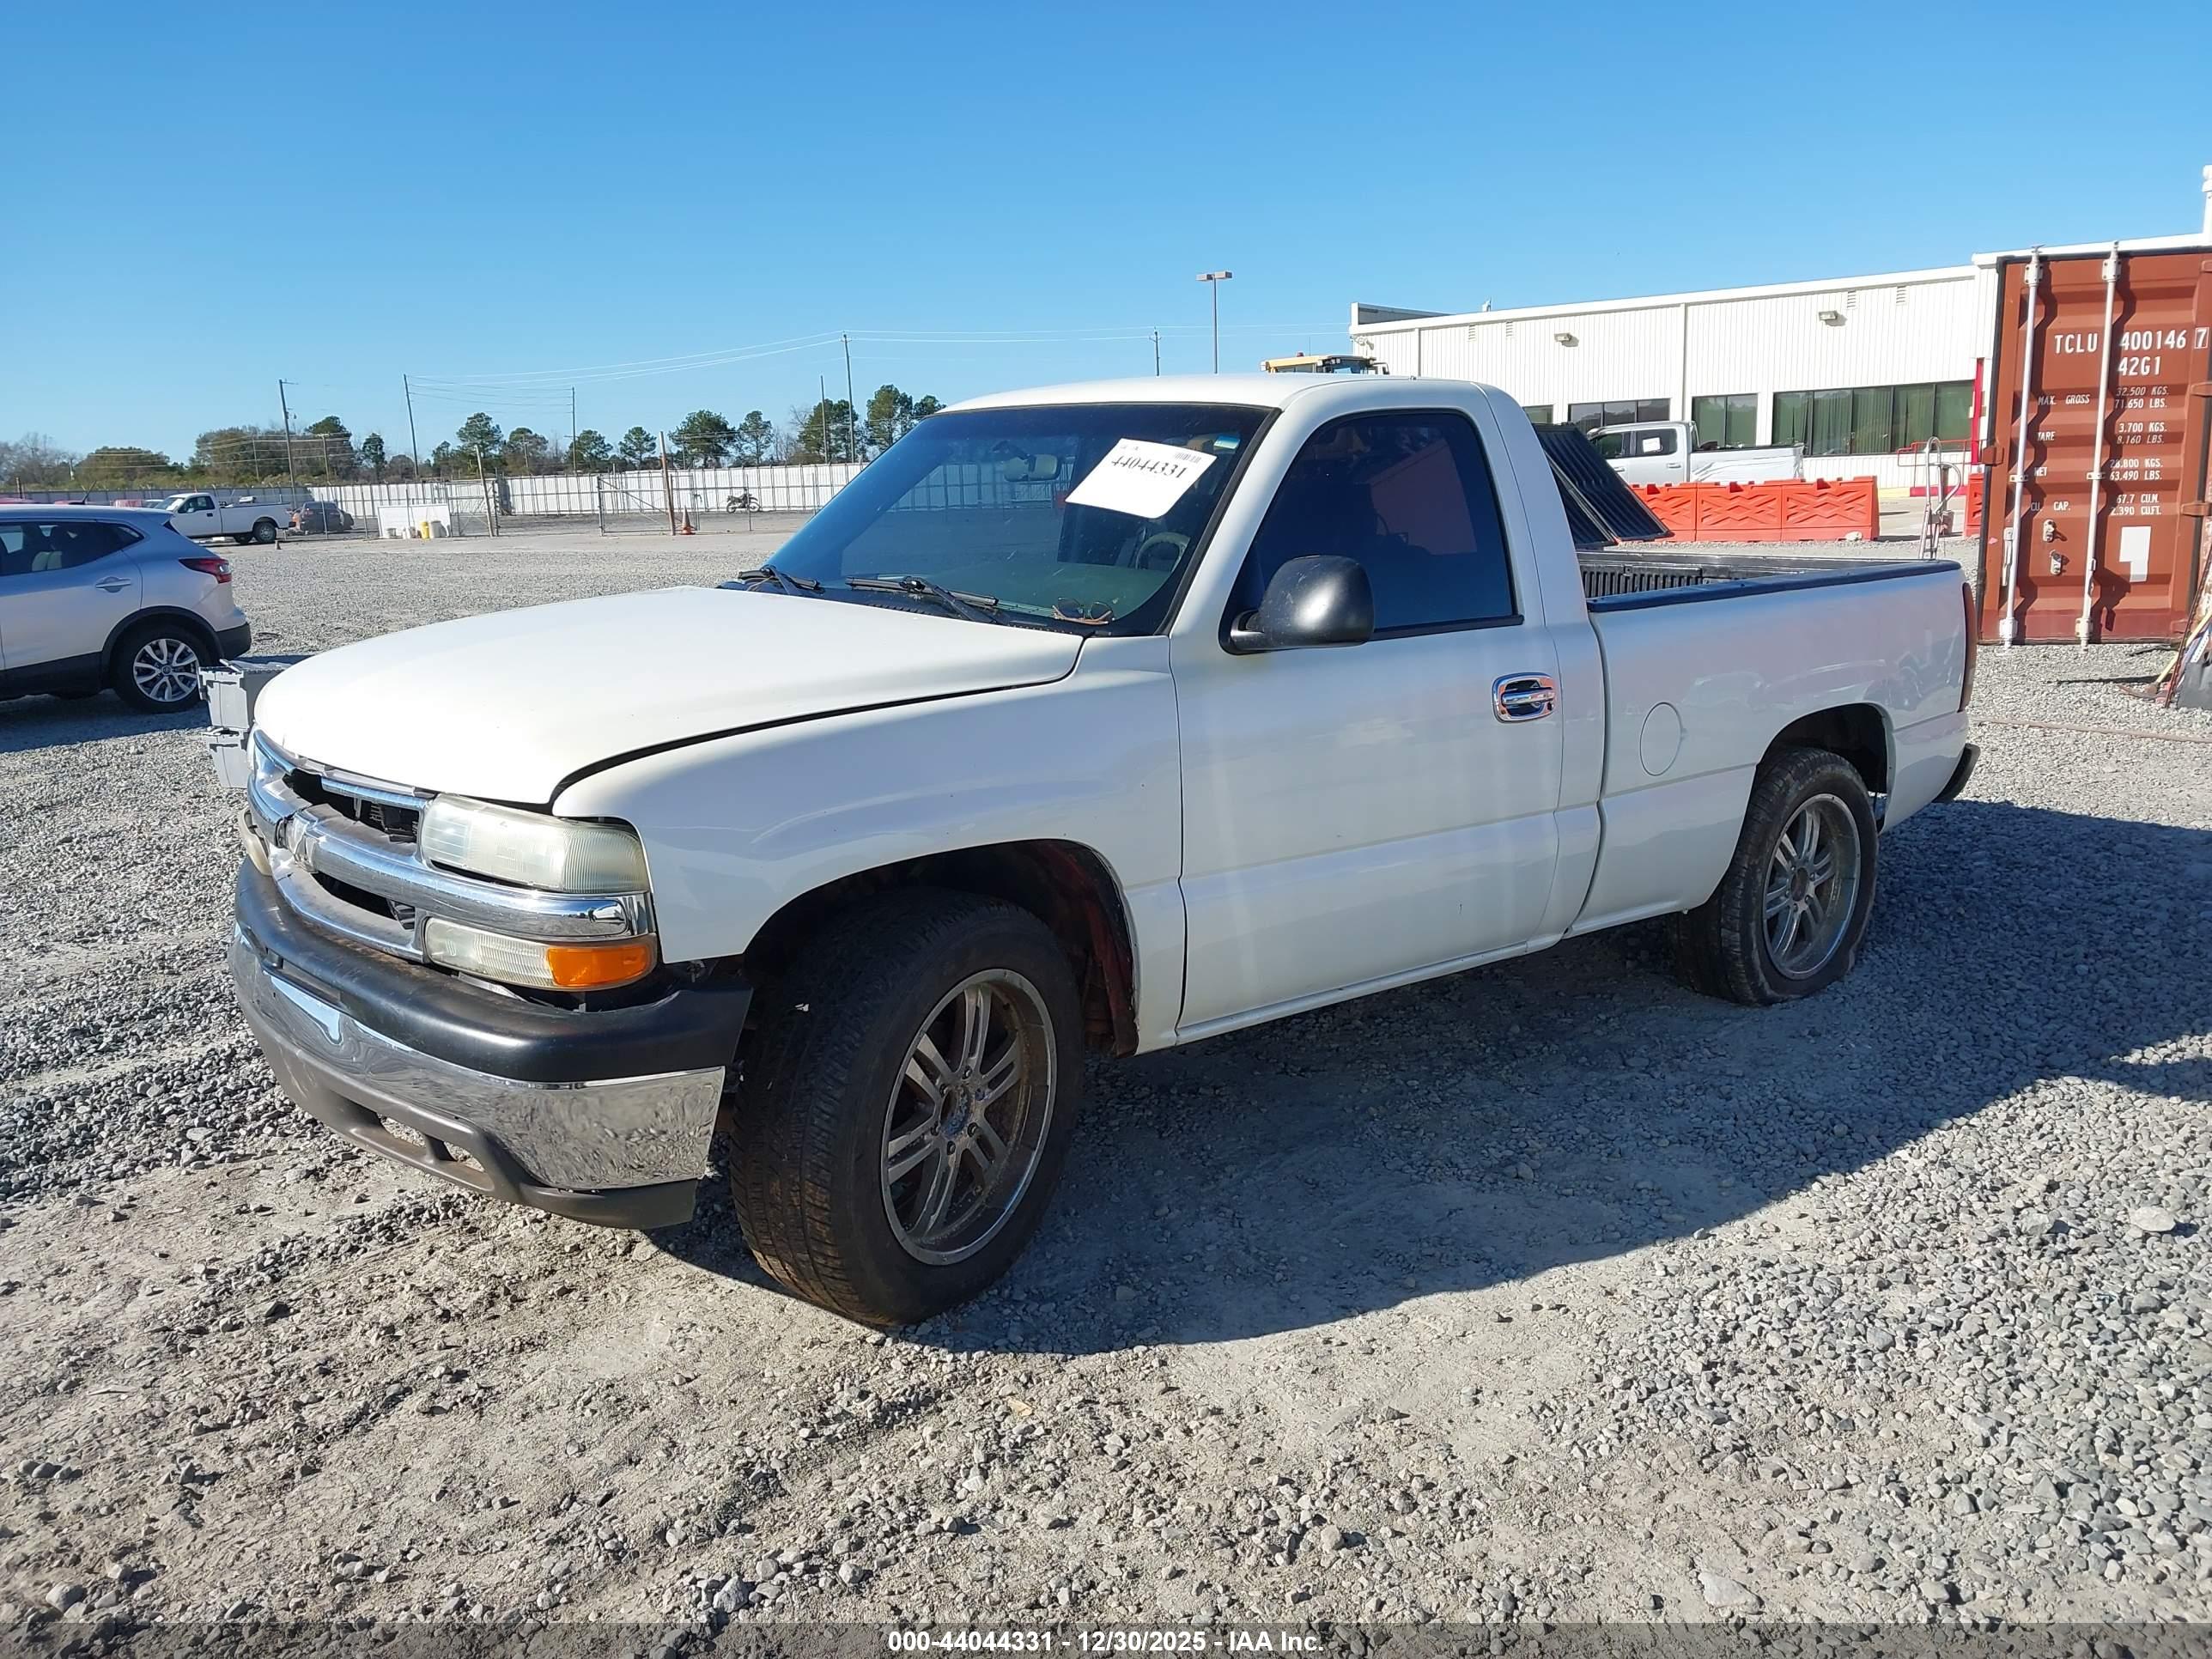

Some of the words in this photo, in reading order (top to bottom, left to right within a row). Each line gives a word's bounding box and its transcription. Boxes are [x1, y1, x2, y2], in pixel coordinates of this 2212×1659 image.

[2055, 333, 2098, 354] TCLU
[2119, 330, 2187, 351] 400146
[2197, 328, 2207, 349] 7
[2118, 356, 2161, 376] 42G1
[2116, 386, 2146, 397] 32.500
[2151, 386, 2170, 395] KGS.
[2038, 395, 2057, 405] MAX.
[2065, 394, 2090, 404] GROSS
[2115, 398, 2144, 409] 71.650
[2149, 398, 2167, 408] LBS.
[2118, 422, 2143, 433] 3.700
[2148, 422, 2167, 432] KGS.
[2038, 432, 2056, 441] TARE
[2117, 434, 2142, 444] 8.160
[2147, 434, 2165, 444] LBS.
[1111, 455, 1188, 478] 44044331
[2144, 458, 2163, 468] KGS.
[2034, 466, 2048, 477] NET
[2109, 471, 2139, 481] 63.490
[2144, 470, 2162, 480] LBS.
[2053, 501, 2071, 511] CAP.
